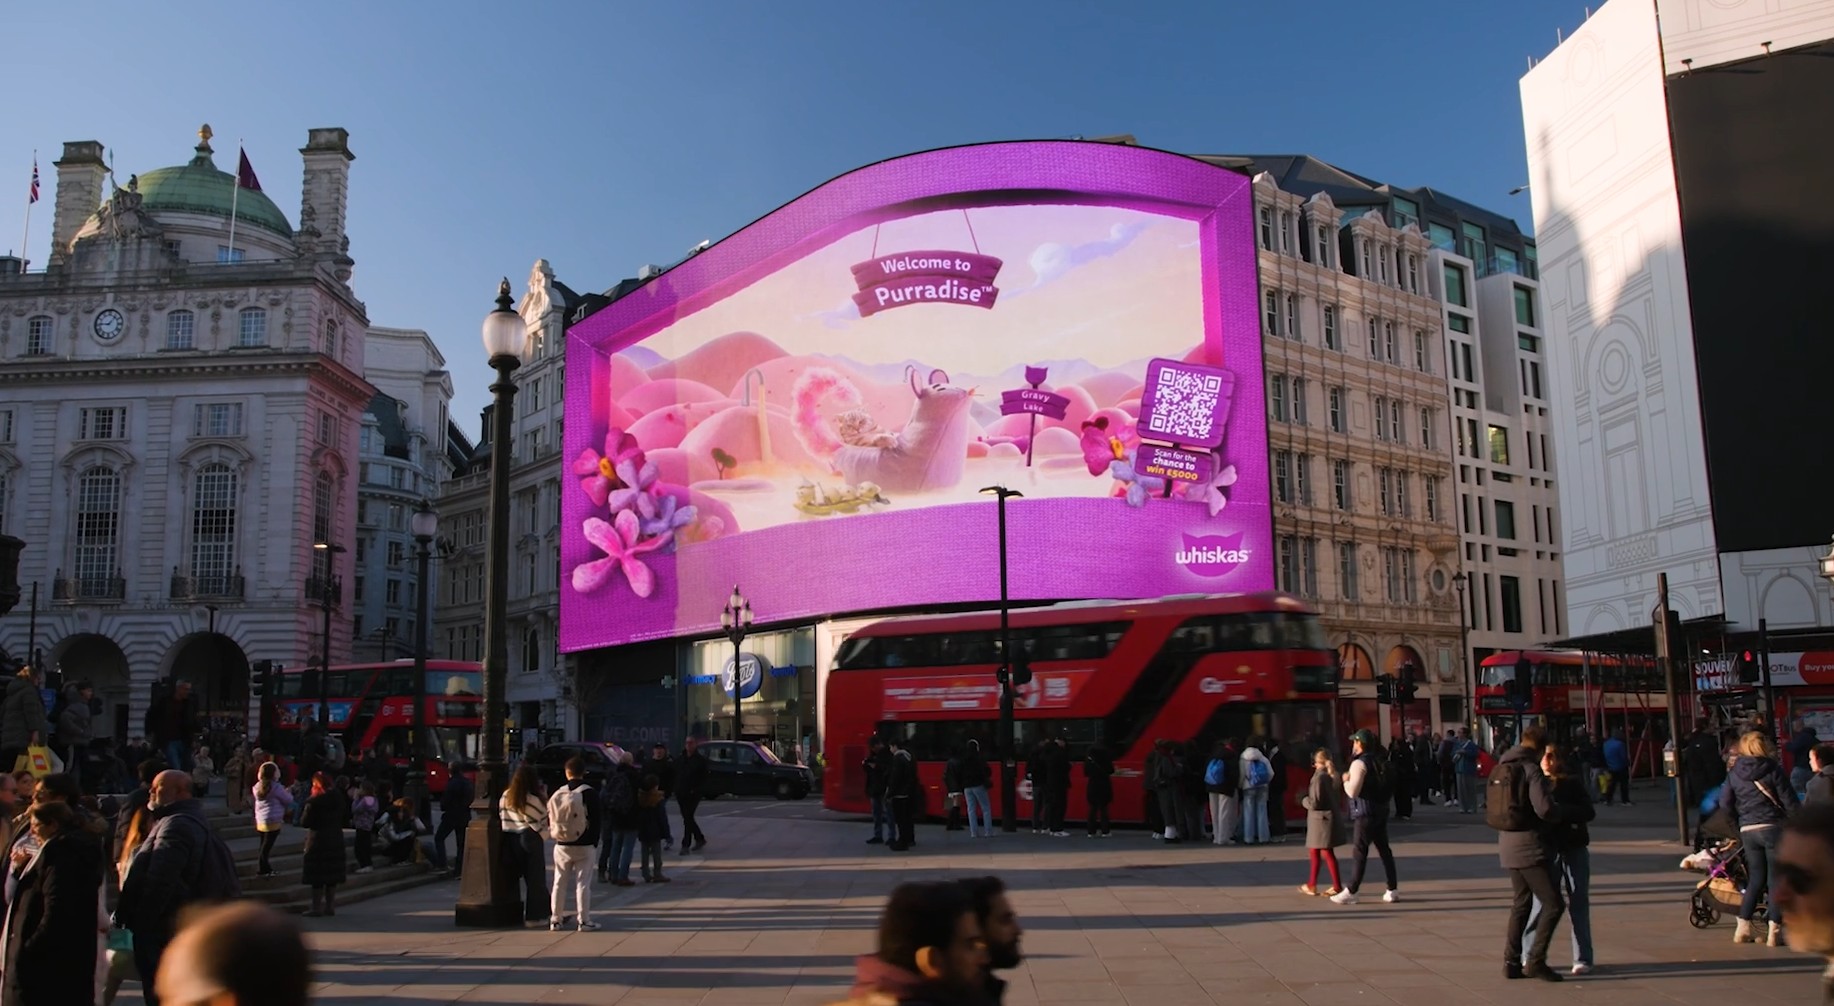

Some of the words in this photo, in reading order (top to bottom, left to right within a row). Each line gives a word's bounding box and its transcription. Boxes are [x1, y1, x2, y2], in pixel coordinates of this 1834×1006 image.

[880, 256, 952, 274] Welcome
[954, 258, 972, 272] to
[1021, 390, 1050, 403] Gravy
[1023, 402, 1044, 412] Lake
[1152, 456, 1185, 469] chance
[1185, 461, 1196, 471] to
[1154, 448, 1172, 458] Scan
[1172, 451, 1184, 460] for
[1184, 454, 1197, 463] the
[1146, 464, 1165, 475] win
[1166, 468, 1198, 481] £5000
[1175, 545, 1250, 565] whiskas
[724, 660, 756, 692] Bots
[1804, 664, 1820, 672] Buy
[602, 725, 671, 743] WELCOME
